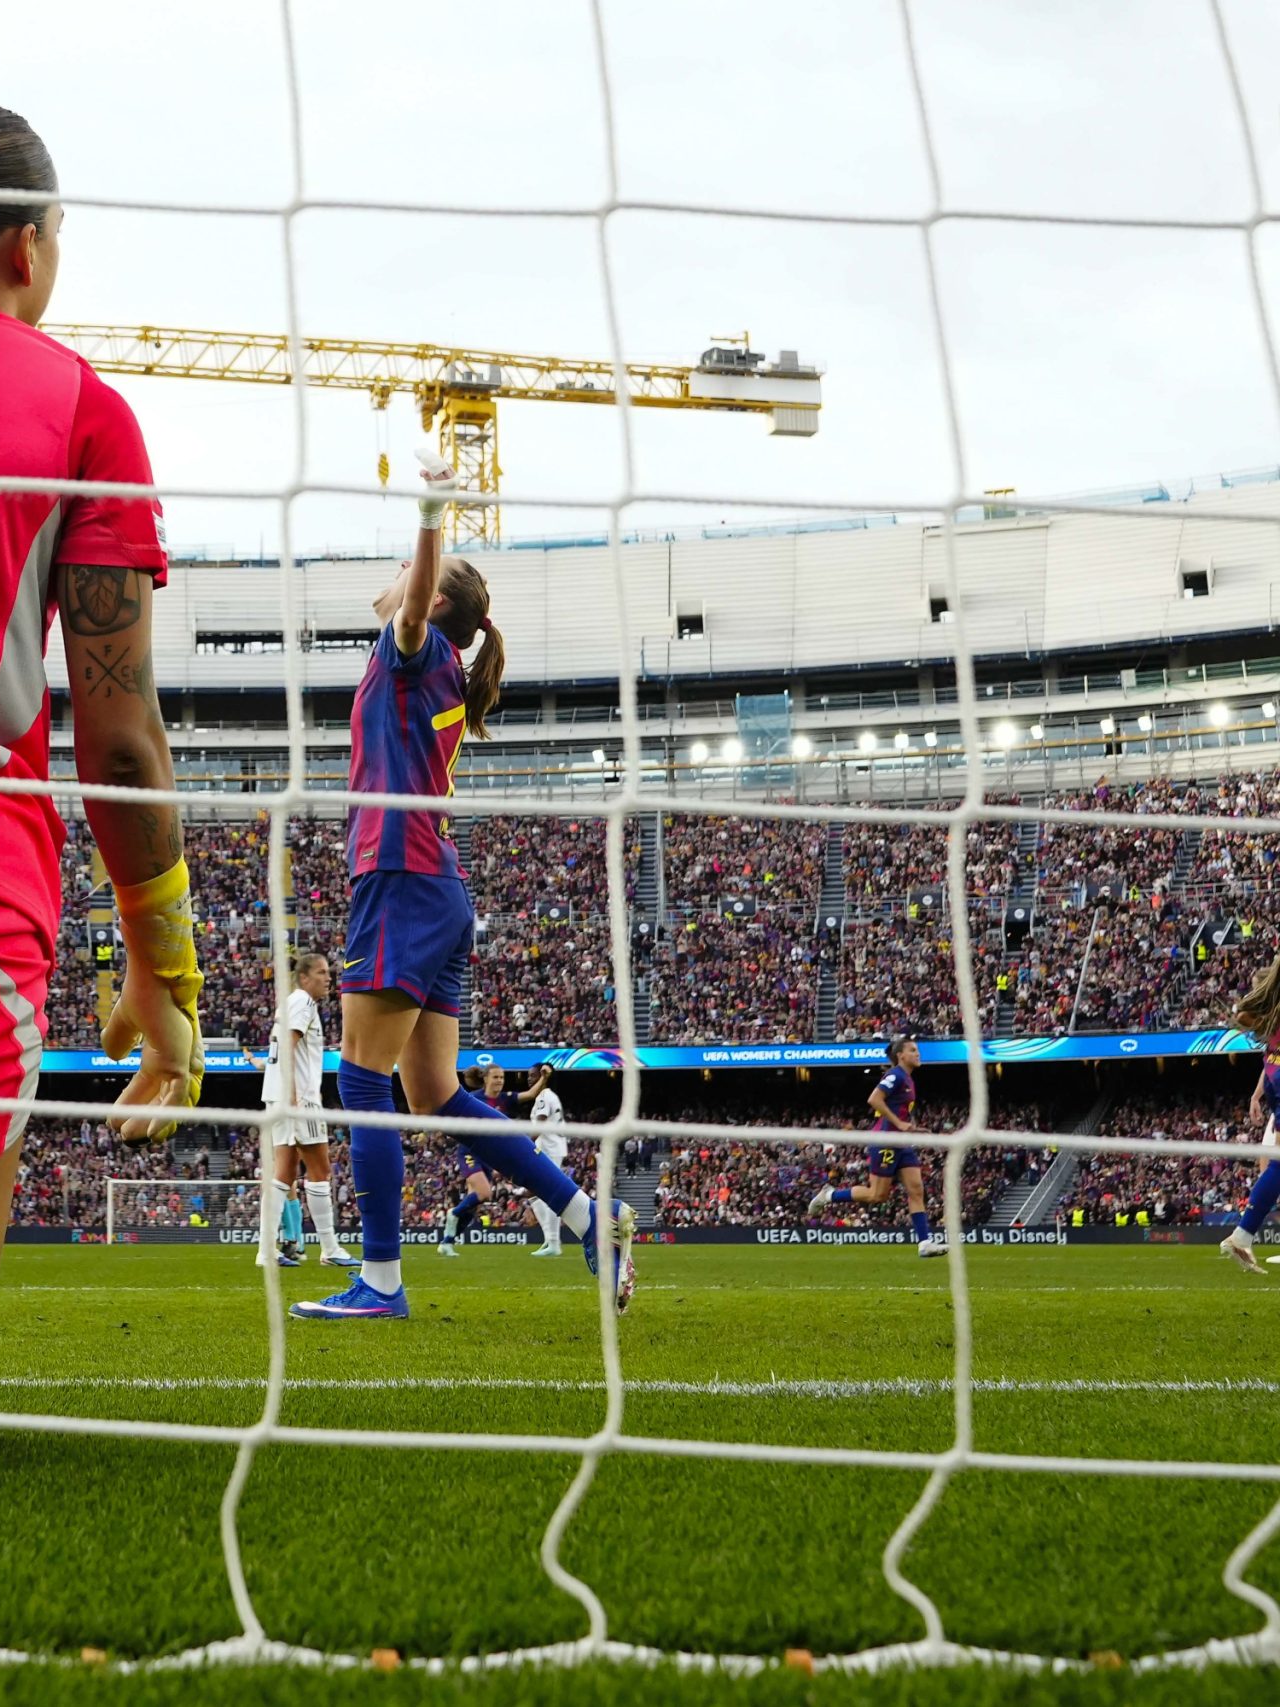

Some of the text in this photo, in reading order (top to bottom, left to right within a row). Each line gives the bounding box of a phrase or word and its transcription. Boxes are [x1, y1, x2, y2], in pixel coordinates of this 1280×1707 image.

[703, 1051, 728, 1062] UEFA
[783, 1048, 851, 1060] CHAMPIONS
[470, 1229, 527, 1245] Disney
[757, 1229, 801, 1243] UEFA
[806, 1229, 905, 1246] Playmakers
[982, 1229, 1004, 1245] by
[1009, 1229, 1067, 1245] Disney
